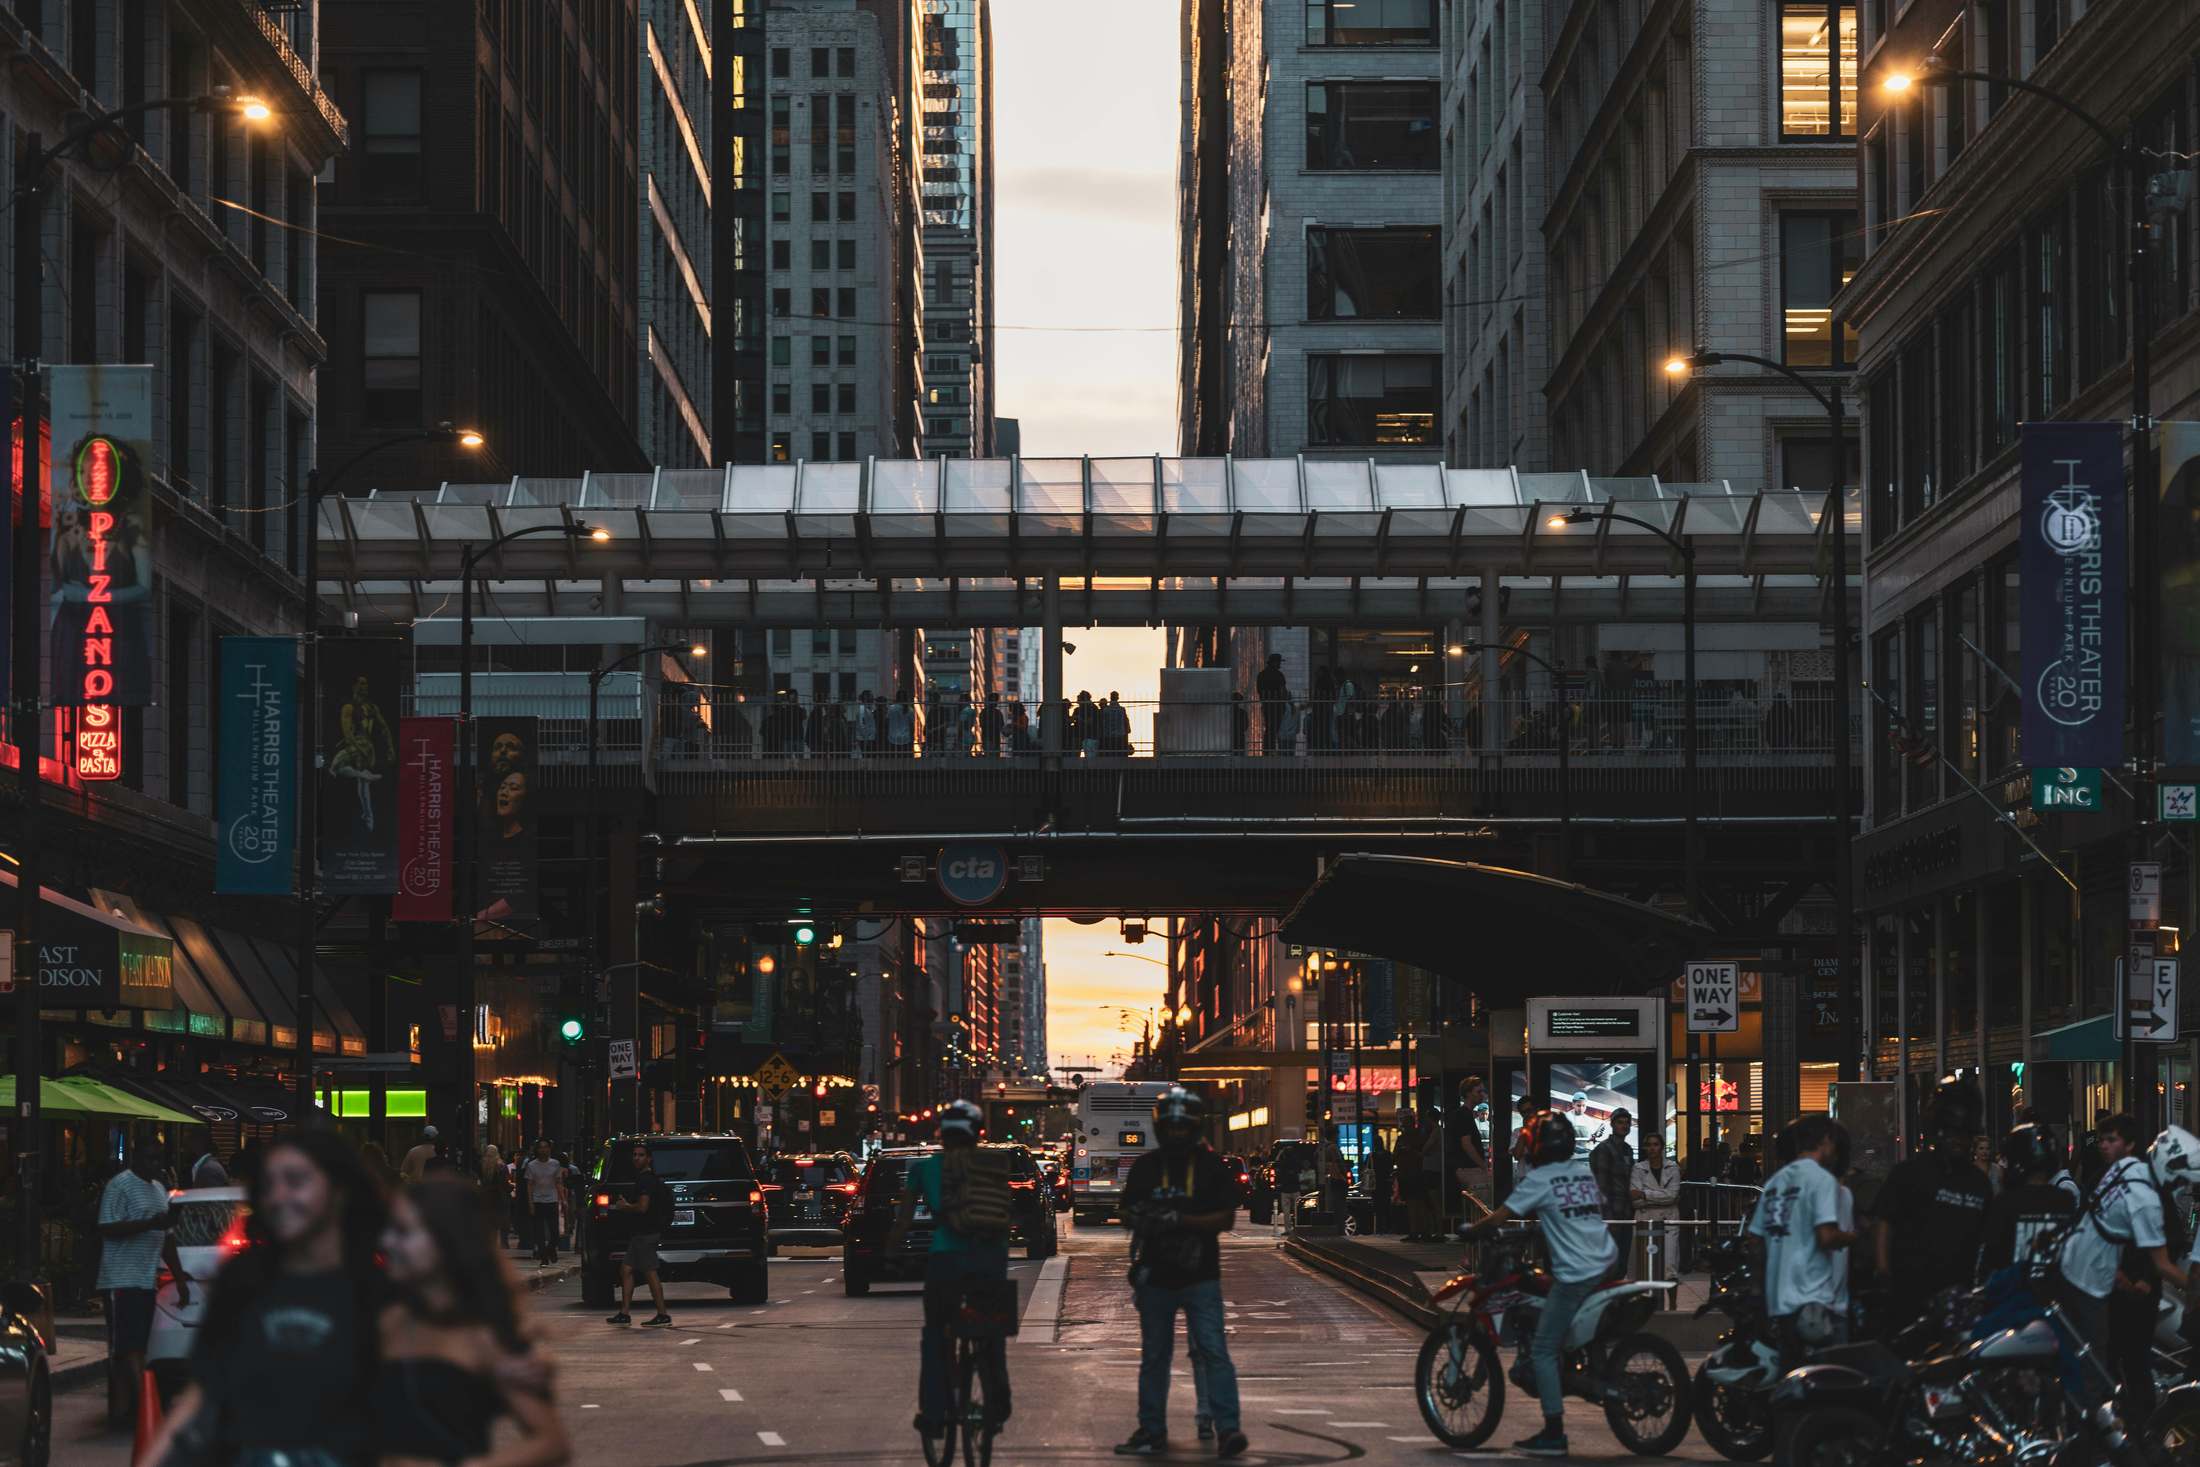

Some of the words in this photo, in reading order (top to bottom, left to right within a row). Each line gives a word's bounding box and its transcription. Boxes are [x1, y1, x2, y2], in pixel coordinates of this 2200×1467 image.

[2080, 496, 2102, 594] HARRIS
[2064, 624, 2075, 662] PARK
[2080, 599, 2102, 712] THEATER
[2057, 676, 2077, 708] 20
[263, 690, 280, 766] HARRIS
[80, 731, 116, 749] PIZZA
[80, 758, 116, 773] PASTA
[428, 759, 442, 819] HARRIS
[2043, 784, 2092, 806] INC
[262, 769, 279, 853] THEATER
[244, 826, 259, 850] 20
[427, 822, 440, 888] THEATER
[414, 866, 425, 888] 20
[949, 857, 995, 879] cta
[40, 945, 77, 965] AST
[40, 968, 104, 987] DISON
[1693, 968, 1731, 984] ONE
[1694, 988, 1732, 1004] WAY
[611, 1042, 631, 1054] ONE
[611, 1053, 632, 1064] WAY
[1126, 1134, 1138, 1143] 56
